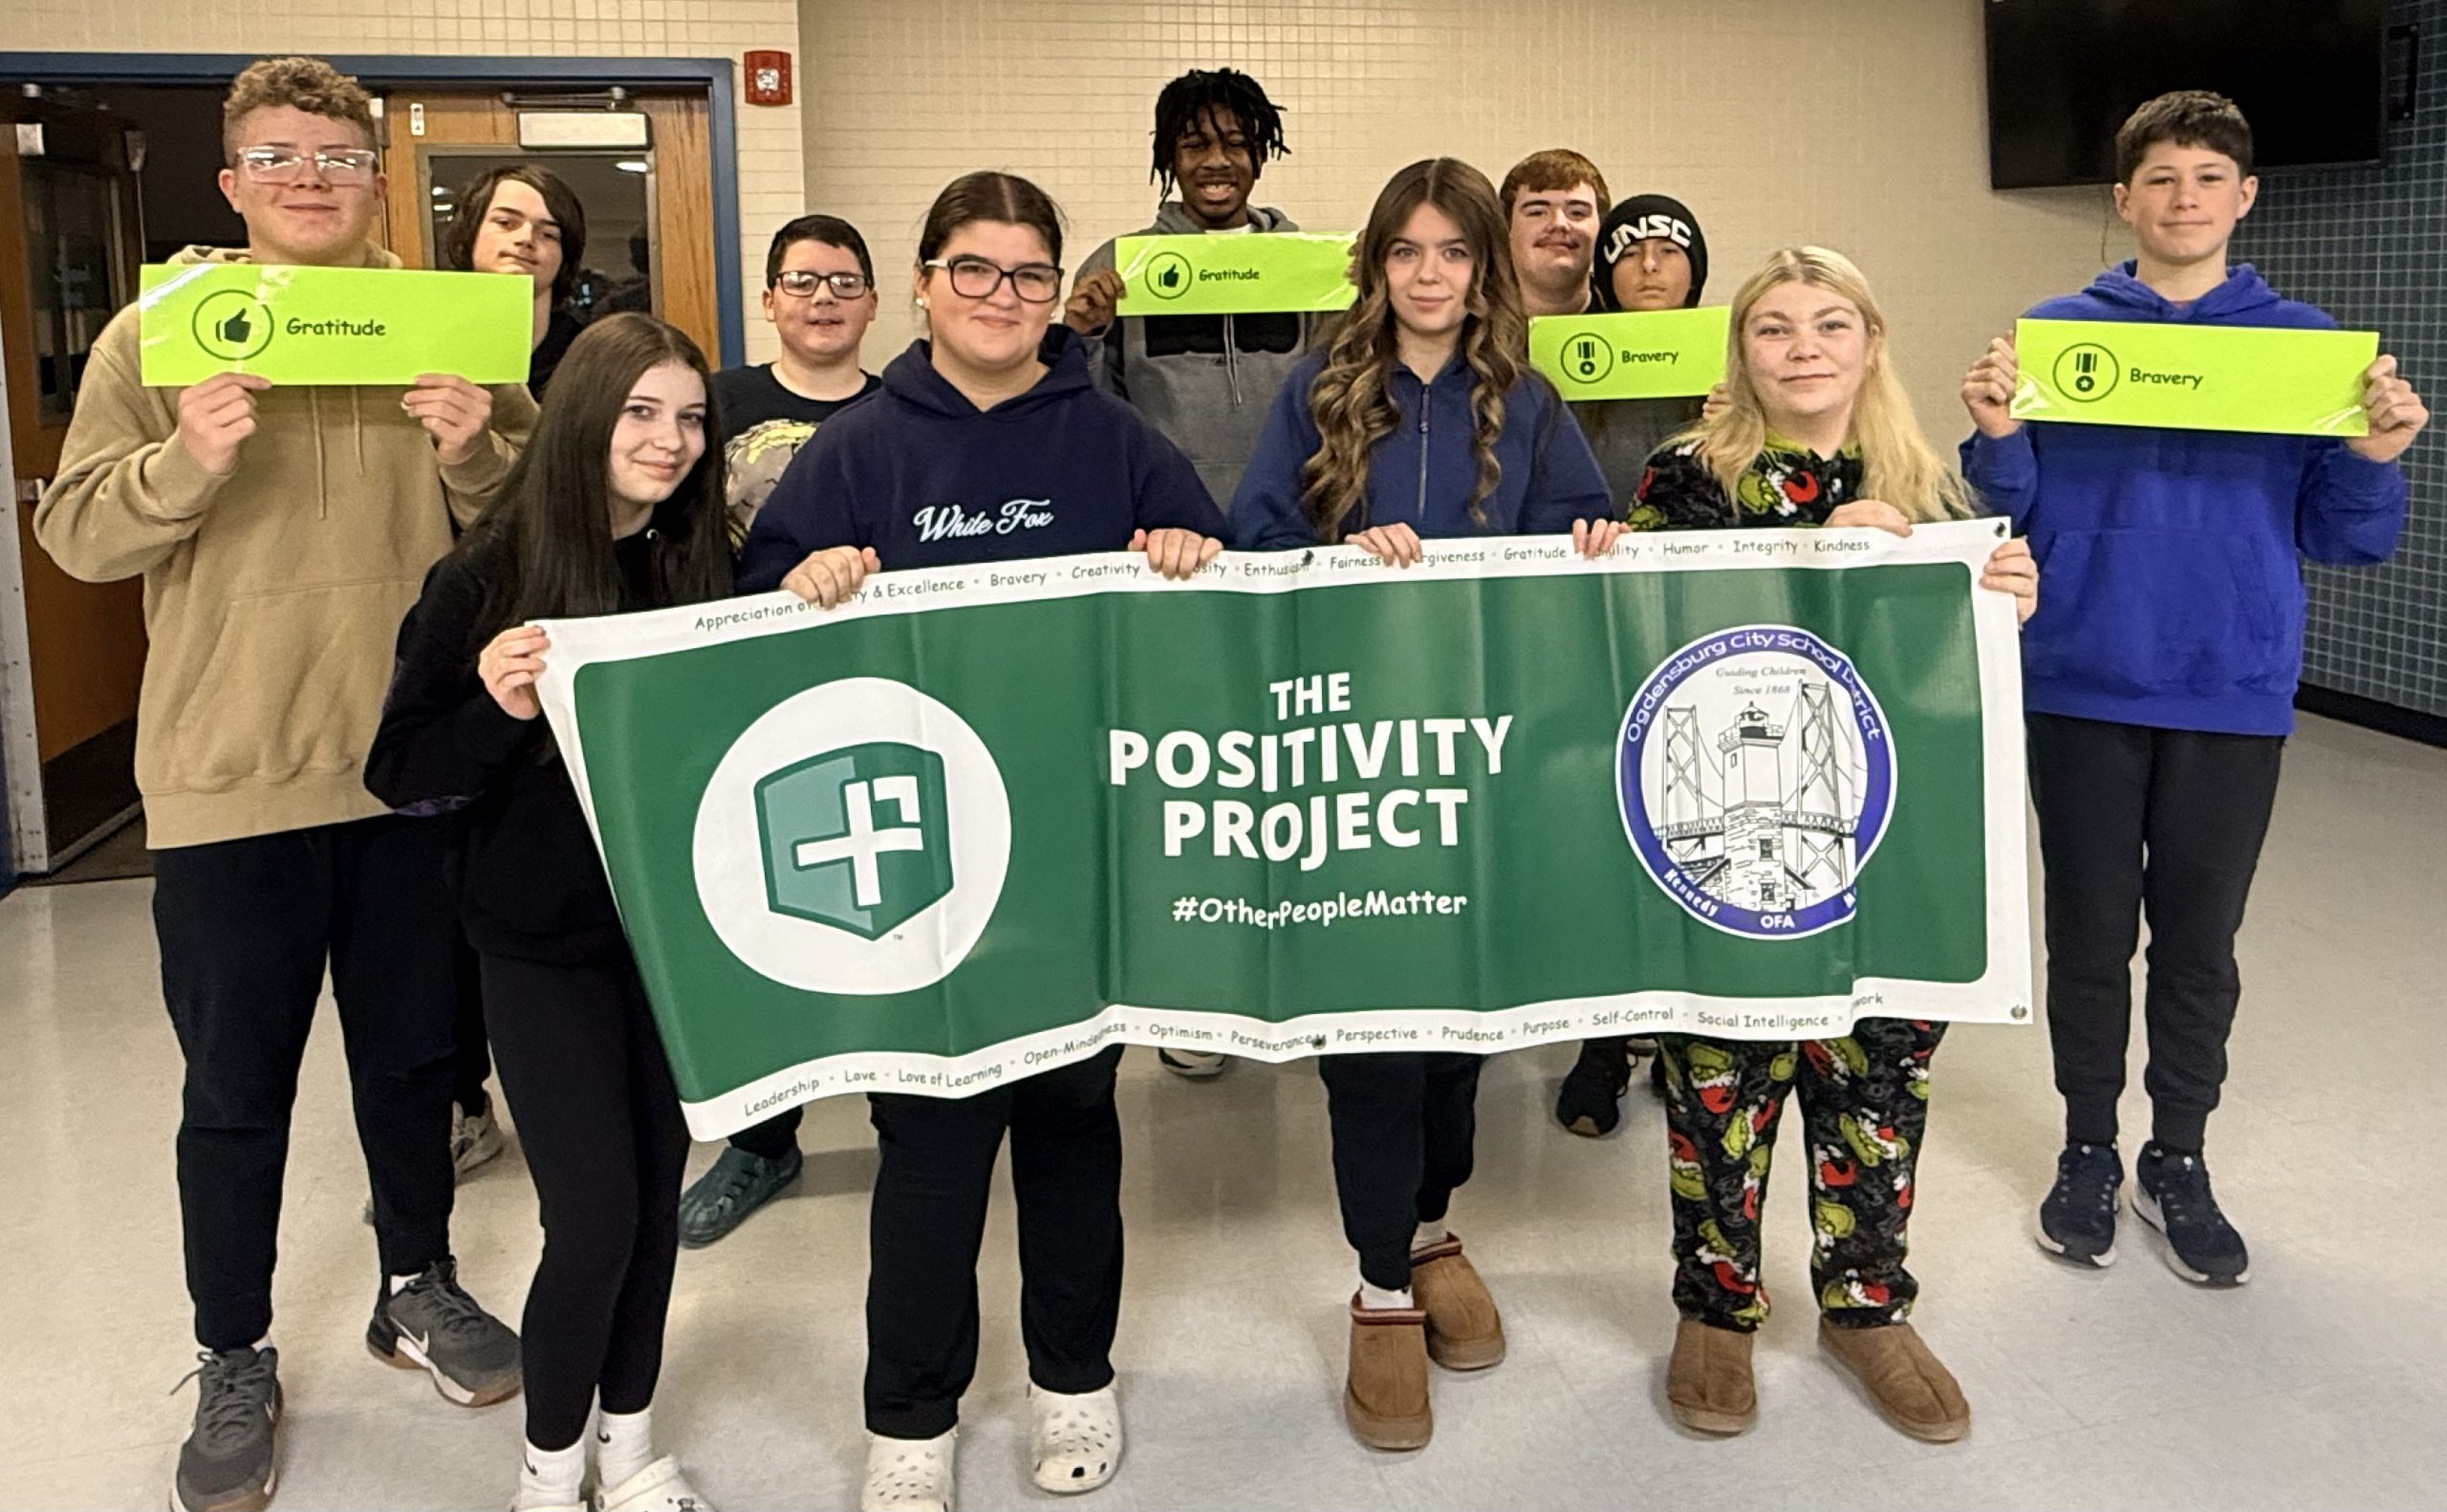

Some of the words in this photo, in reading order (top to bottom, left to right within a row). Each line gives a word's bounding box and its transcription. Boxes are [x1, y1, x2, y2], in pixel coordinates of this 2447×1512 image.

[1604, 214, 1692, 265] UNSC
[1199, 268, 1260, 281] Gratitude
[286, 317, 386, 335] Gratitude
[1621, 350, 1678, 364] Bravery
[2130, 367, 2203, 390] Bravery
[913, 504, 994, 542] White
[995, 499, 1054, 534] Fox
[695, 604, 792, 631] Appreciation
[873, 585, 882, 598] &
[887, 578, 964, 596] Excellence
[990, 572, 1047, 587] Bravery
[1072, 563, 1140, 578] Creativity
[1193, 562, 1226, 577] osity
[1330, 555, 1381, 569] Fairness
[1504, 546, 1567, 560] Gratitude
[1663, 542, 1708, 555] Humor
[1733, 540, 1798, 557] Integrity
[1813, 539, 1870, 551] Kindness
[1627, 640, 1726, 743] Ogdensburg
[1730, 632, 1775, 650] City
[1778, 634, 1842, 673] School
[1716, 667, 1758, 679] Guiding
[1761, 666, 1807, 677] Children
[1733, 685, 1762, 695] Since
[1269, 672, 1351, 720] THE
[1109, 715, 1513, 792] POSITIVITY
[1163, 788, 1468, 872] PROJECT
[1172, 890, 1467, 929] #OtherPeopleMatter
[1663, 868, 1719, 918] Kennedy
[1761, 915, 1795, 929] OFA
[745, 1076, 819, 1116] Leadership
[844, 1069, 877, 1083] Love
[899, 1069, 926, 1085] Love
[930, 1073, 942, 1087] of
[946, 1064, 1002, 1088] Learning
[1149, 1024, 1212, 1040] Optimism
[1230, 1029, 1312, 1051] Perseverance
[1336, 1028, 1418, 1044] Perspective
[1441, 1026, 1504, 1041] Prudence
[1523, 1019, 1570, 1035] Purpose
[1592, 1007, 1674, 1026] Self-Control
[1698, 1011, 1739, 1026] Social
[1743, 1013, 1829, 1030] Intelligence
